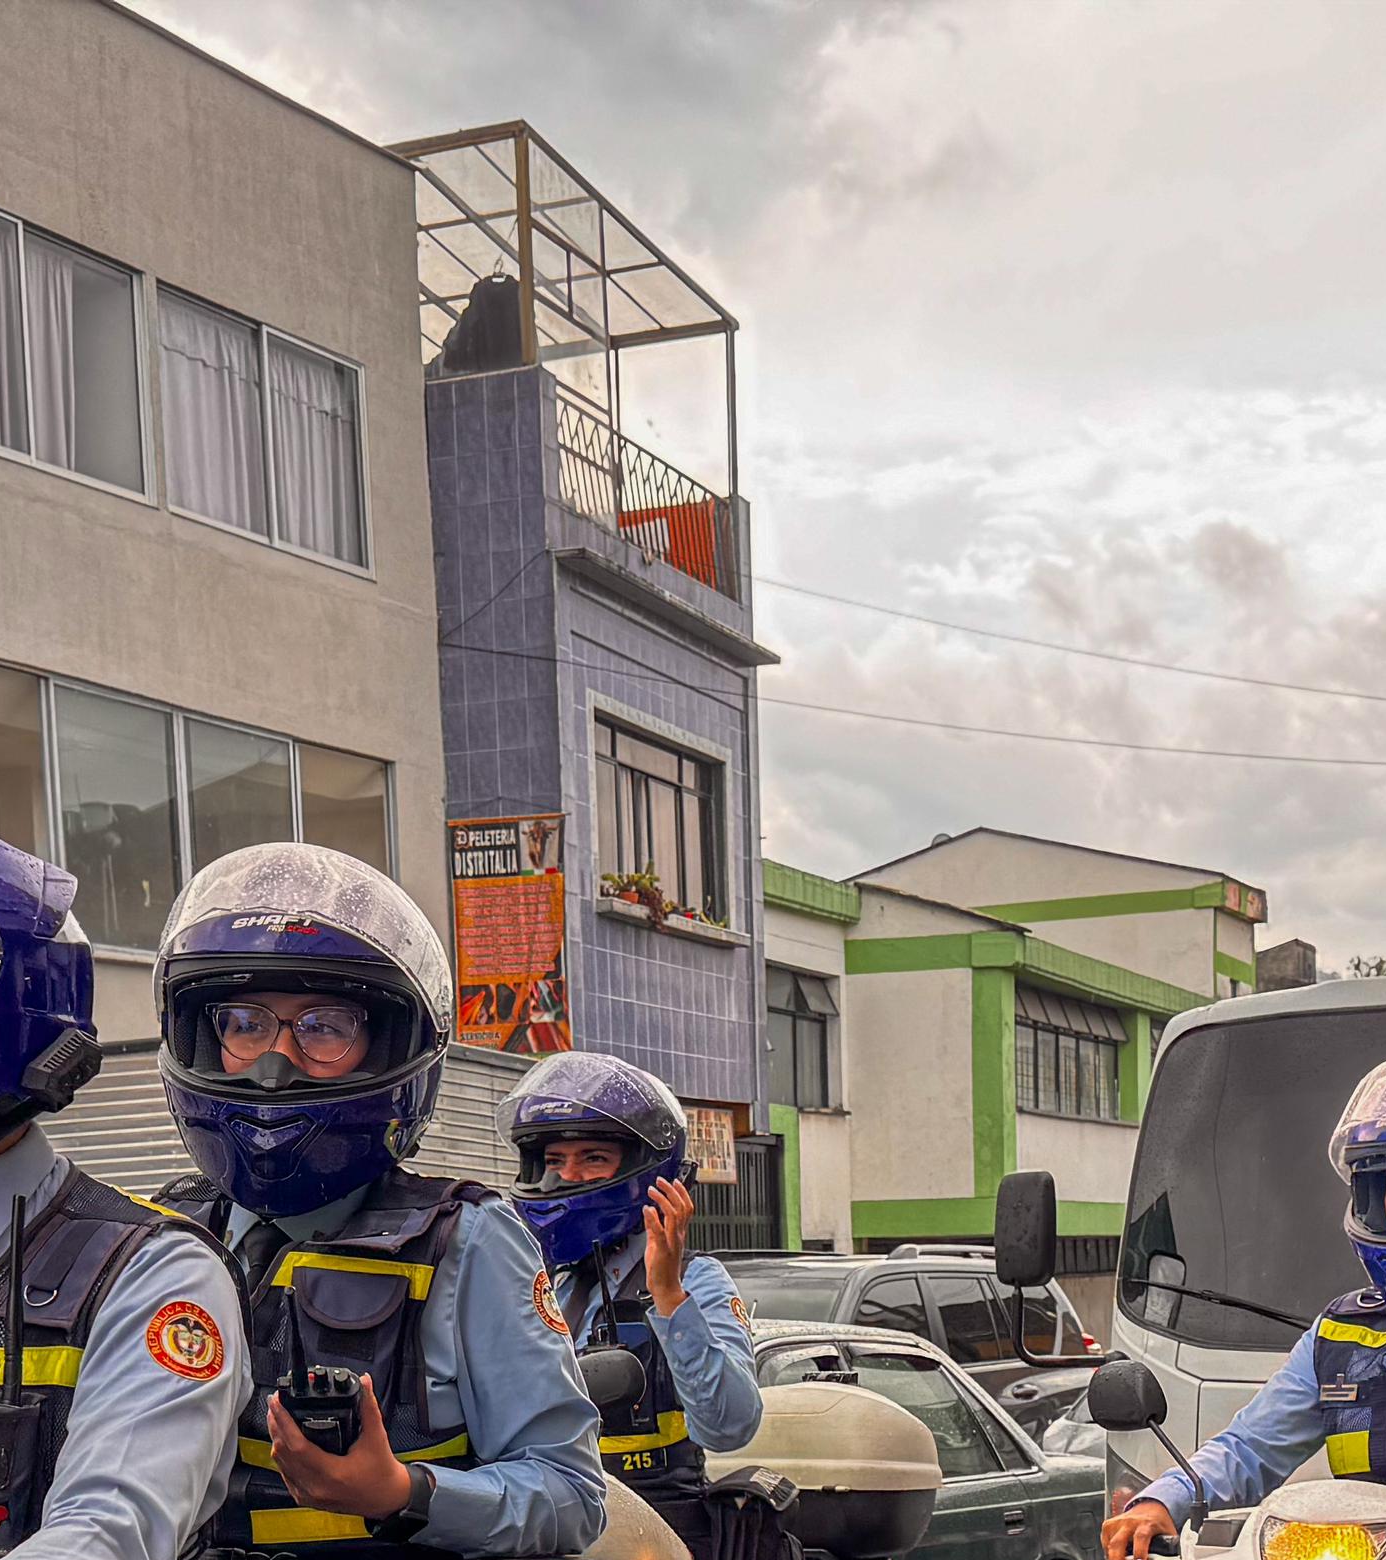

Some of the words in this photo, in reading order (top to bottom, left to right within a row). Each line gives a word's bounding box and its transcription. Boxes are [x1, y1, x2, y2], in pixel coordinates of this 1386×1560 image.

[454, 849, 519, 877] DISTRITALIA
[231, 914, 314, 929] SHAFT
[622, 1452, 652, 1471] 215
